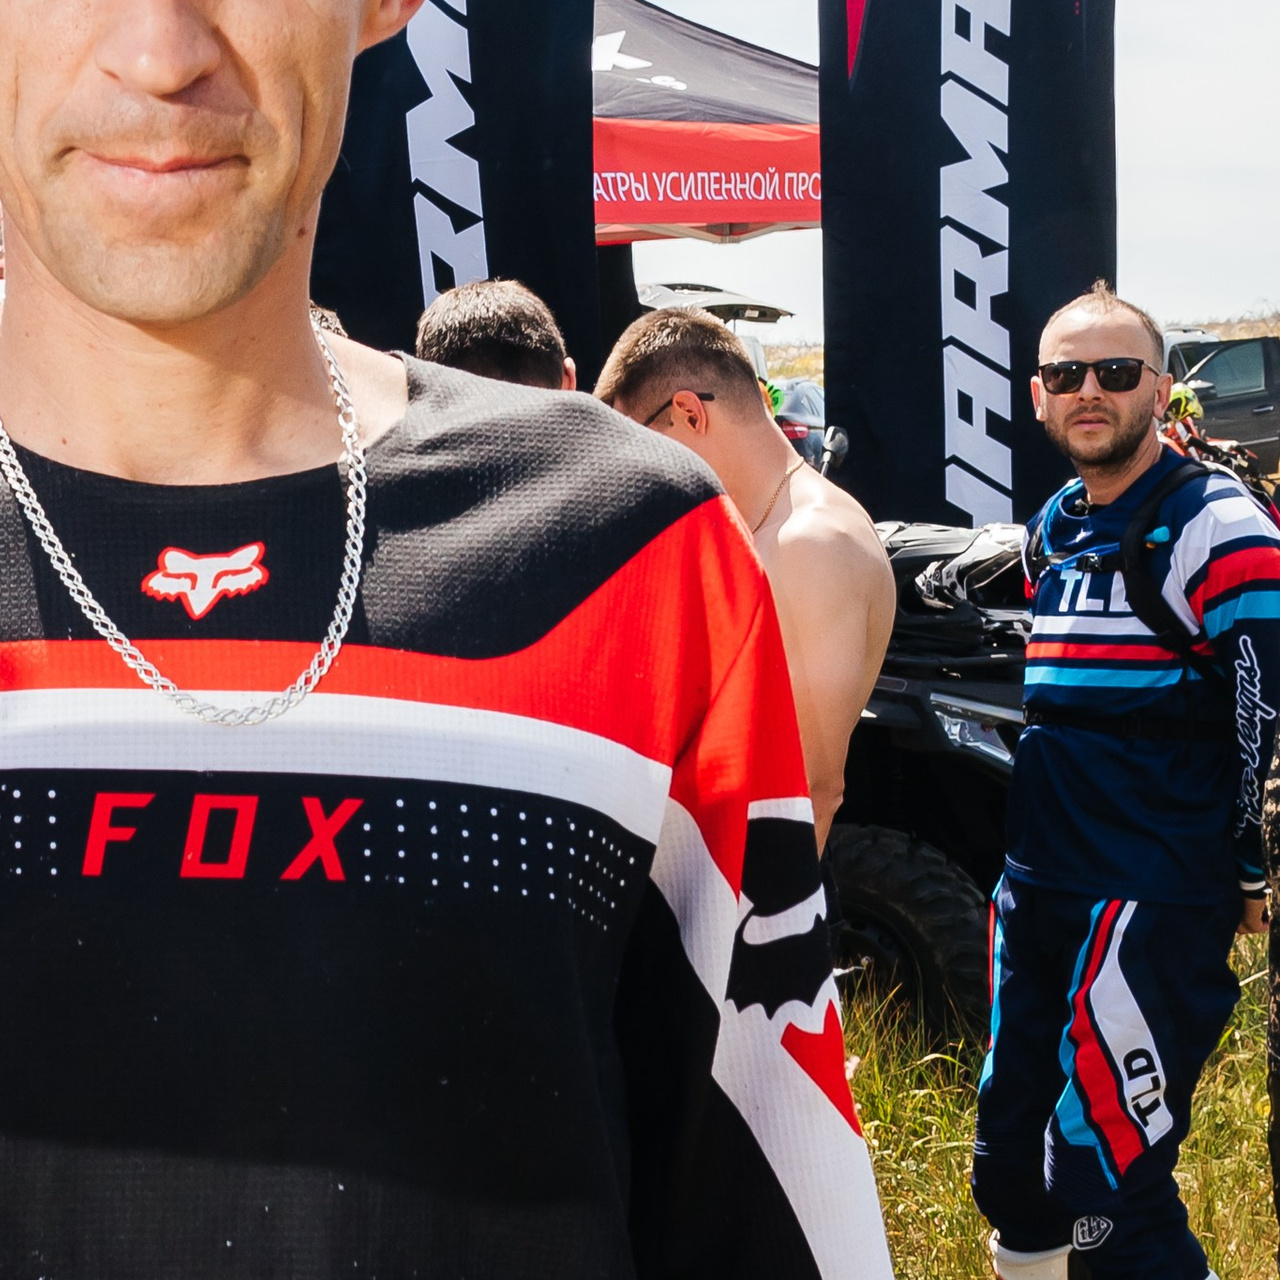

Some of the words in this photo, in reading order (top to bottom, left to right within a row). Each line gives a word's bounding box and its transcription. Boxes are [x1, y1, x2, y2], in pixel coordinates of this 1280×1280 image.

[652, 167, 782, 202] УСИЛЕННОЙ
[81, 792, 364, 881] FOX
[1123, 1047, 1162, 1129] TLD
